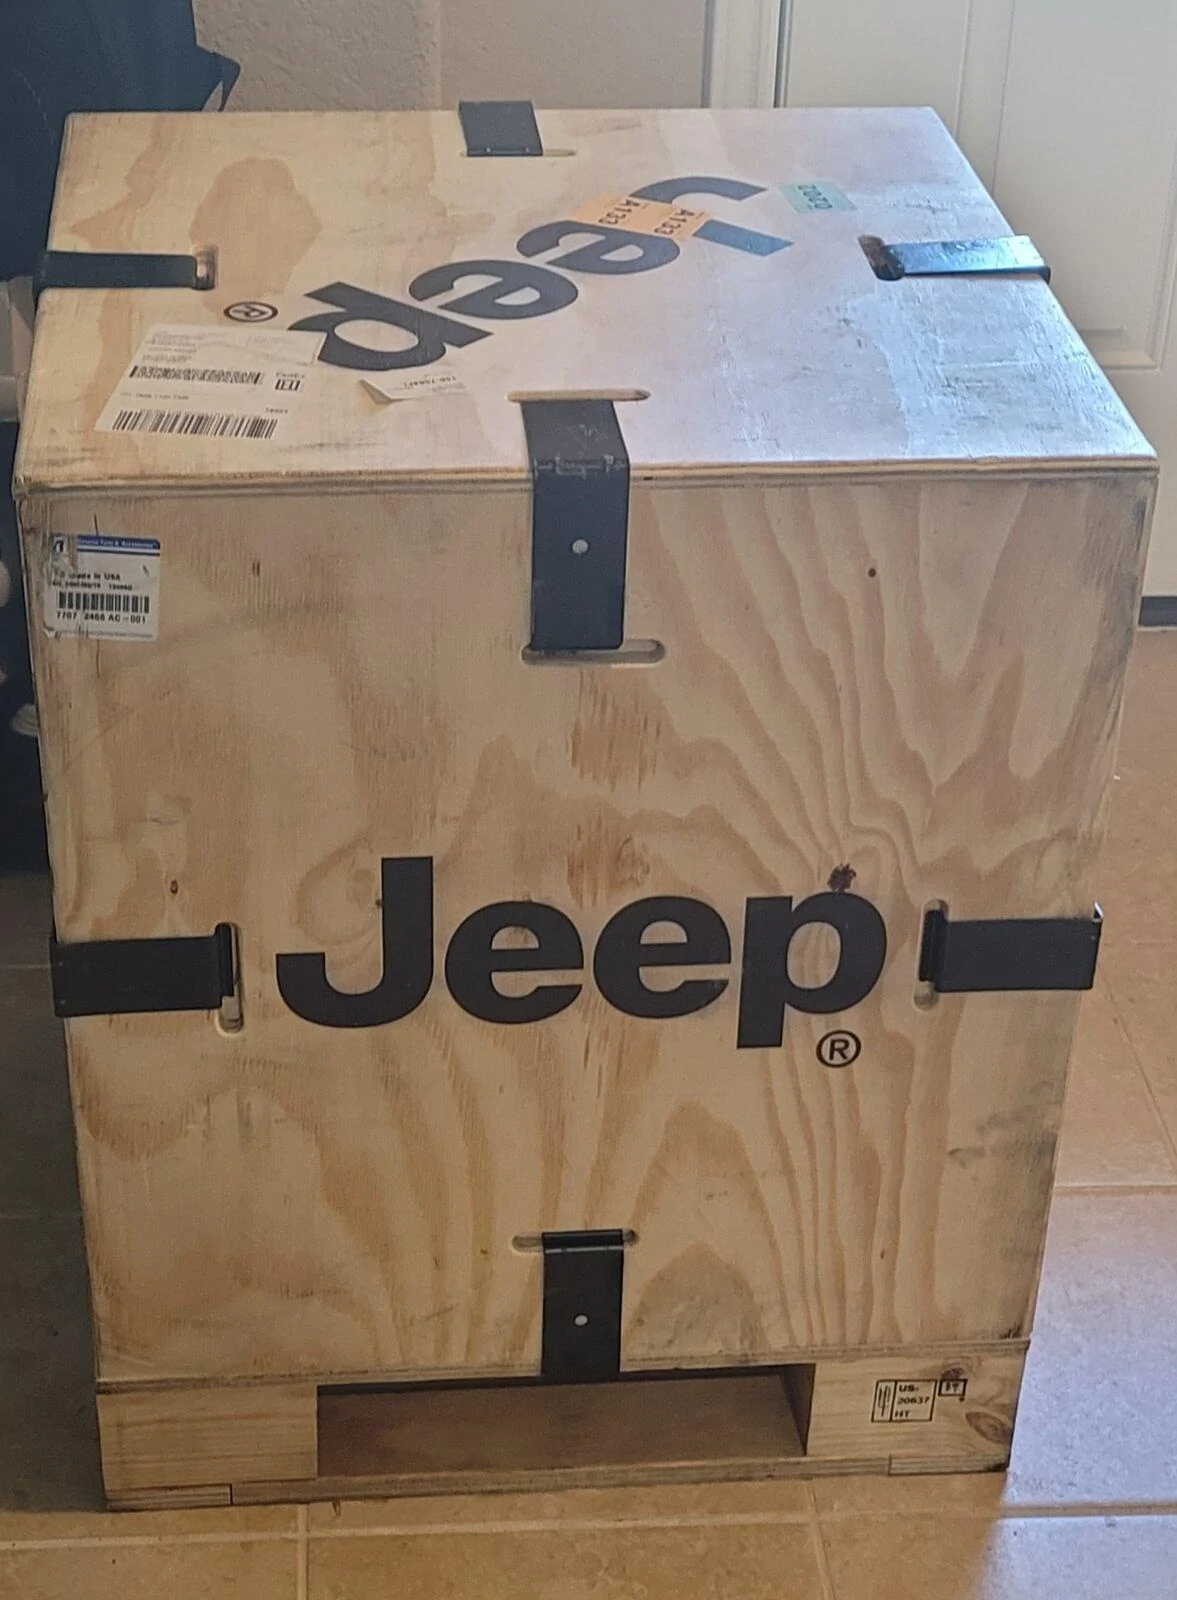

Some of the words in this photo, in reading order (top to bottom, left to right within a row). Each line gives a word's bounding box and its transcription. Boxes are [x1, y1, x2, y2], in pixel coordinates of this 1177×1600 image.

[598, 199, 640, 225] A133
[654, 208, 695, 236] A133
[287, 176, 795, 371] Jeep
[104, 573, 121, 581] USA
[275, 856, 887, 1049] Jeep
